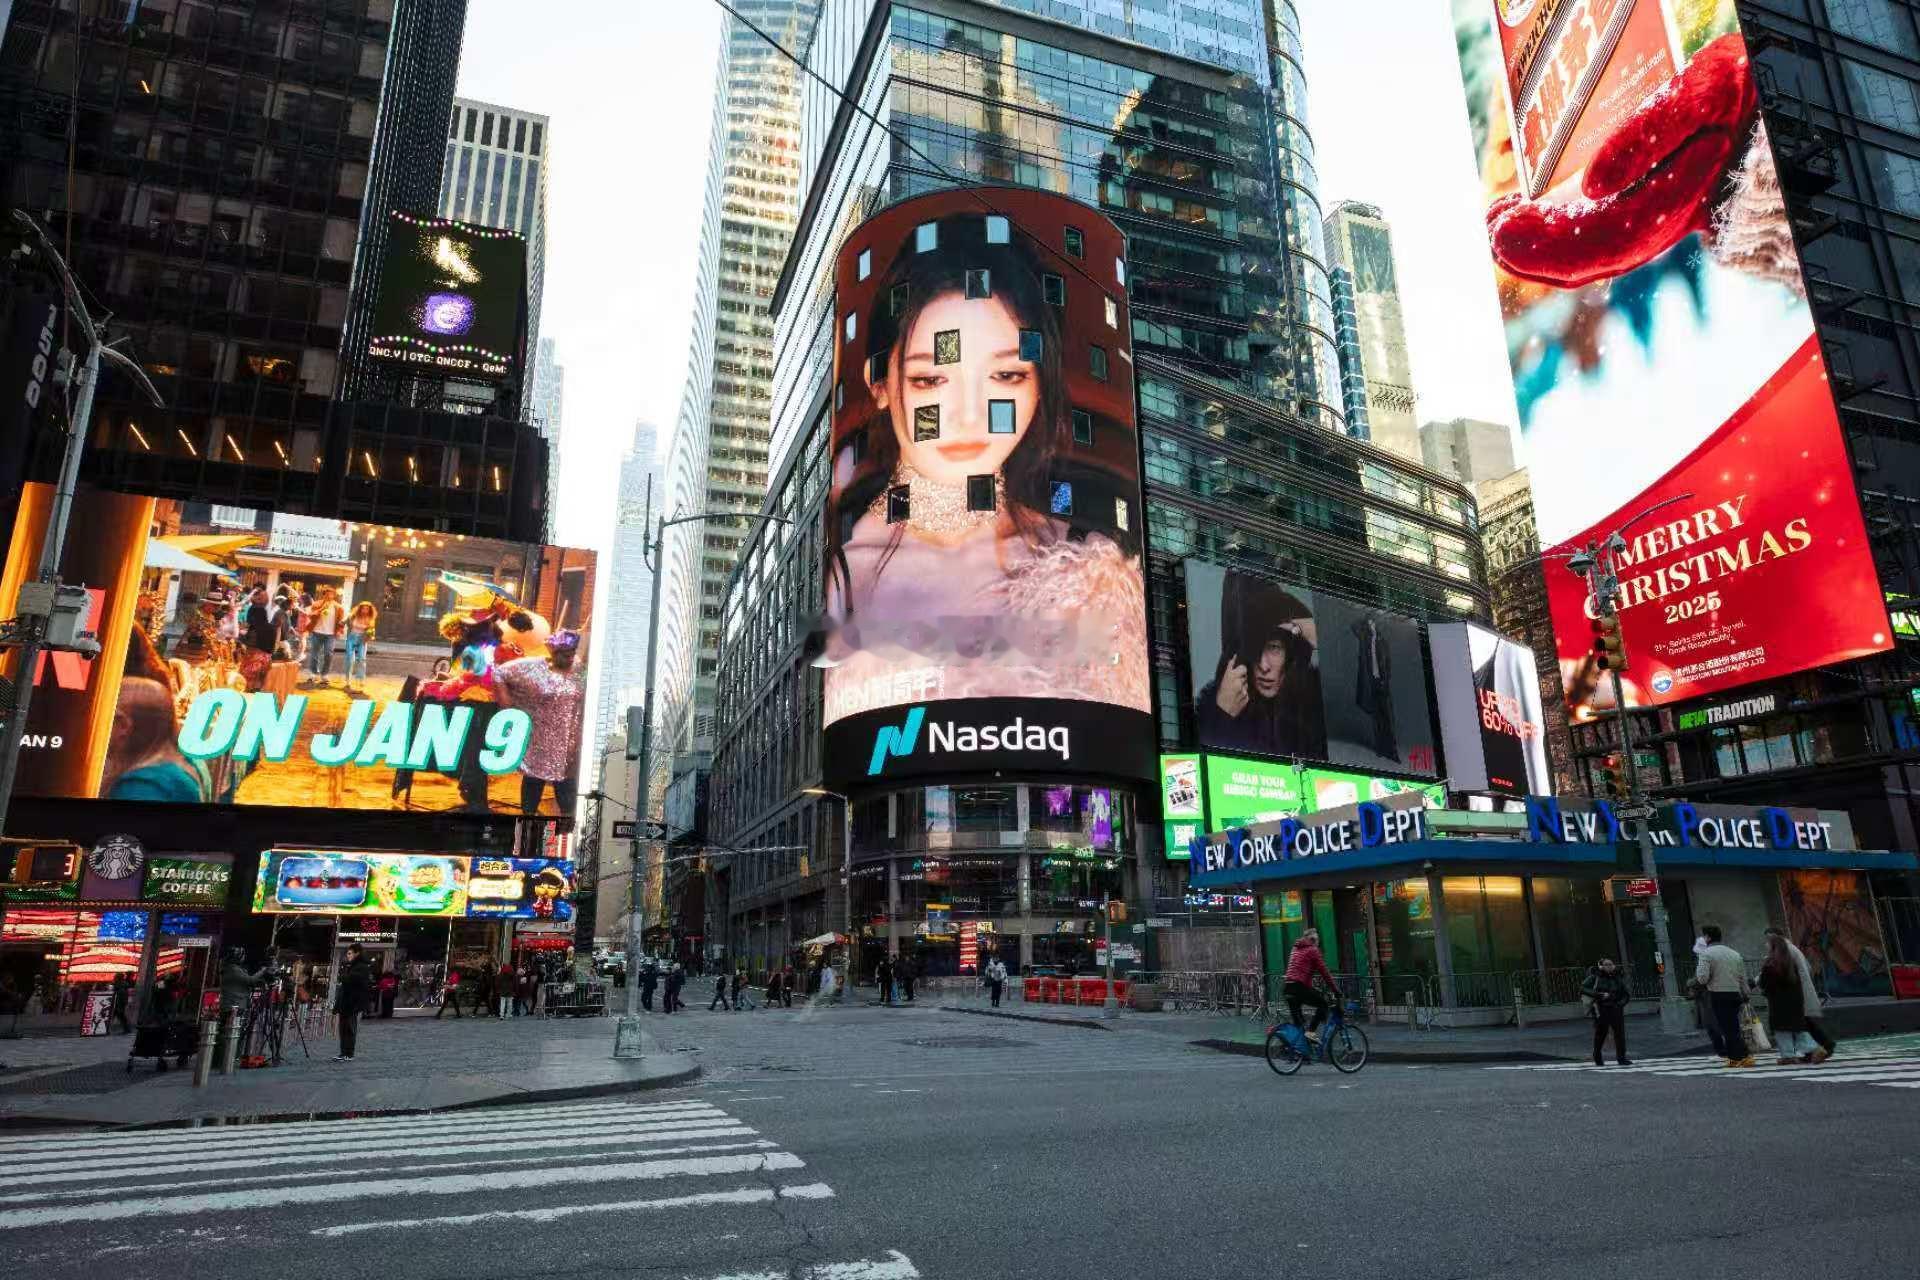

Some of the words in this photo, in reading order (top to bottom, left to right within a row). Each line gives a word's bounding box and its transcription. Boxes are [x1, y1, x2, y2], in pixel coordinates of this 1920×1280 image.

[436, 356, 472, 369] QNCCF
[1616, 494, 1747, 572] MERRY
[1664, 591, 1722, 625] 2025
[178, 688, 308, 762] ON
[310, 699, 474, 771] JAN
[479, 707, 532, 774] 9
[1483, 708, 1513, 736] 60%
[50, 735, 63, 748] 9
[928, 717, 1070, 760] Nasdaq
[1526, 794, 1597, 841] NEW
[1676, 802, 1764, 848] POLICE
[1763, 806, 1832, 850] DEPT
[1190, 835, 1226, 876] NEW
[1226, 828, 1277, 869] YORK
[1280, 817, 1352, 861] POLICE
[1357, 801, 1424, 848] DEPT
[63, 853, 75, 875] 3
[151, 866, 229, 883] STARBUCKS
[161, 882, 211, 895] COFFEE
